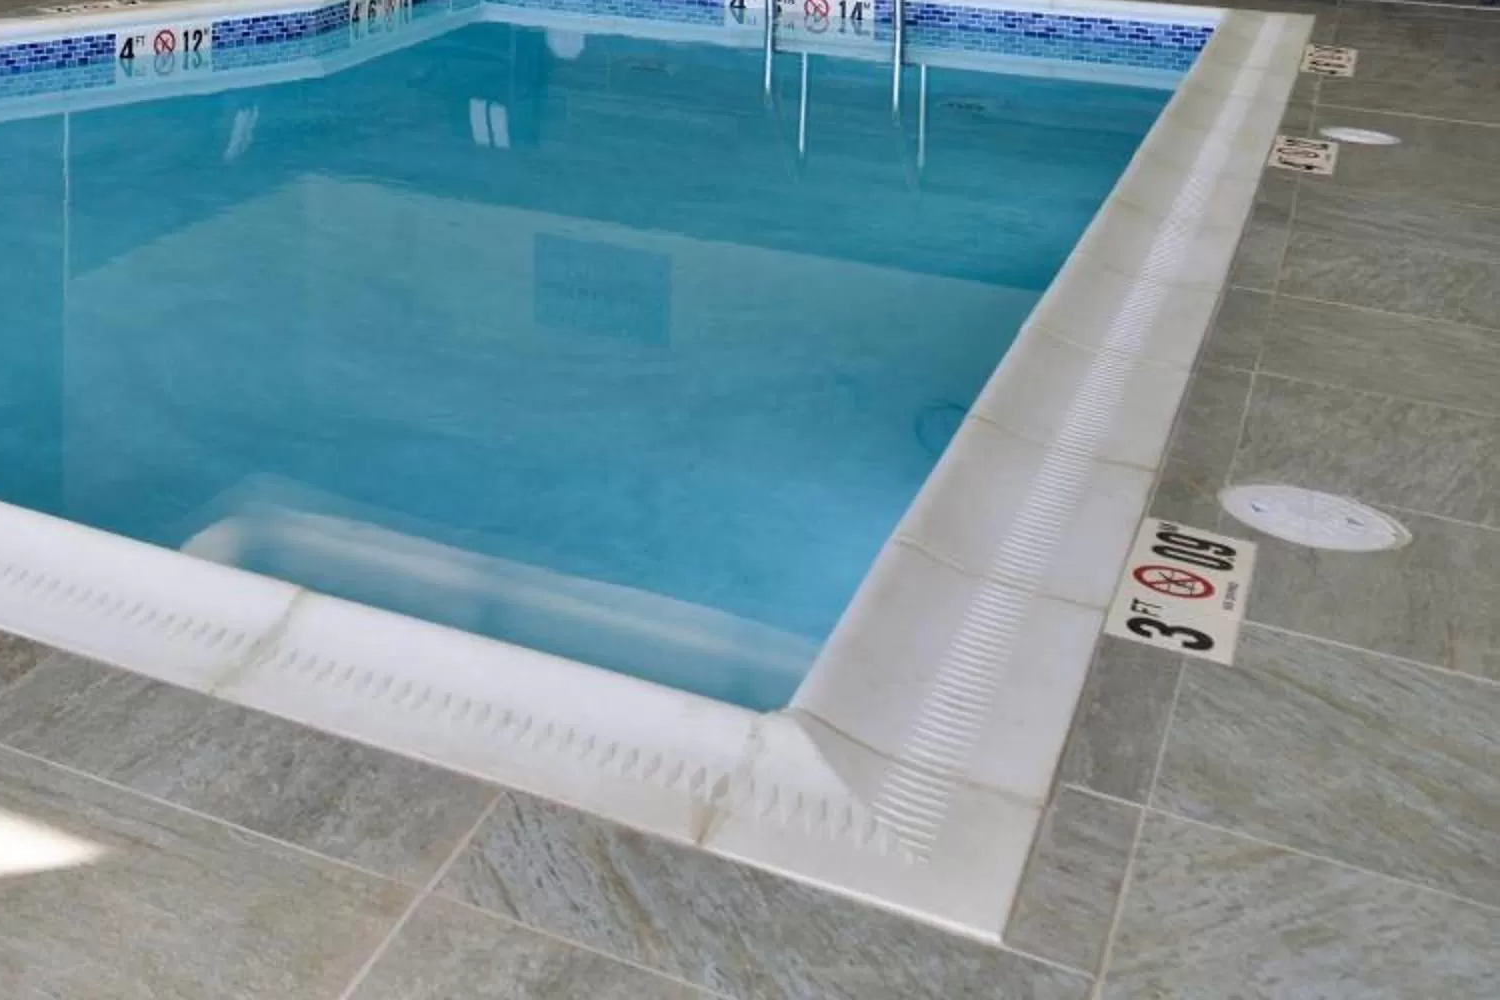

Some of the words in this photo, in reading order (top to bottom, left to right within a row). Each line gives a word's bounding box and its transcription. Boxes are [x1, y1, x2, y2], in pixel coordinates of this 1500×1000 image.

[119, 37, 135, 59] 4
[1152, 531, 1238, 571] 0.9
[1130, 597, 1163, 617] FT
[1126, 617, 1214, 651] 3
